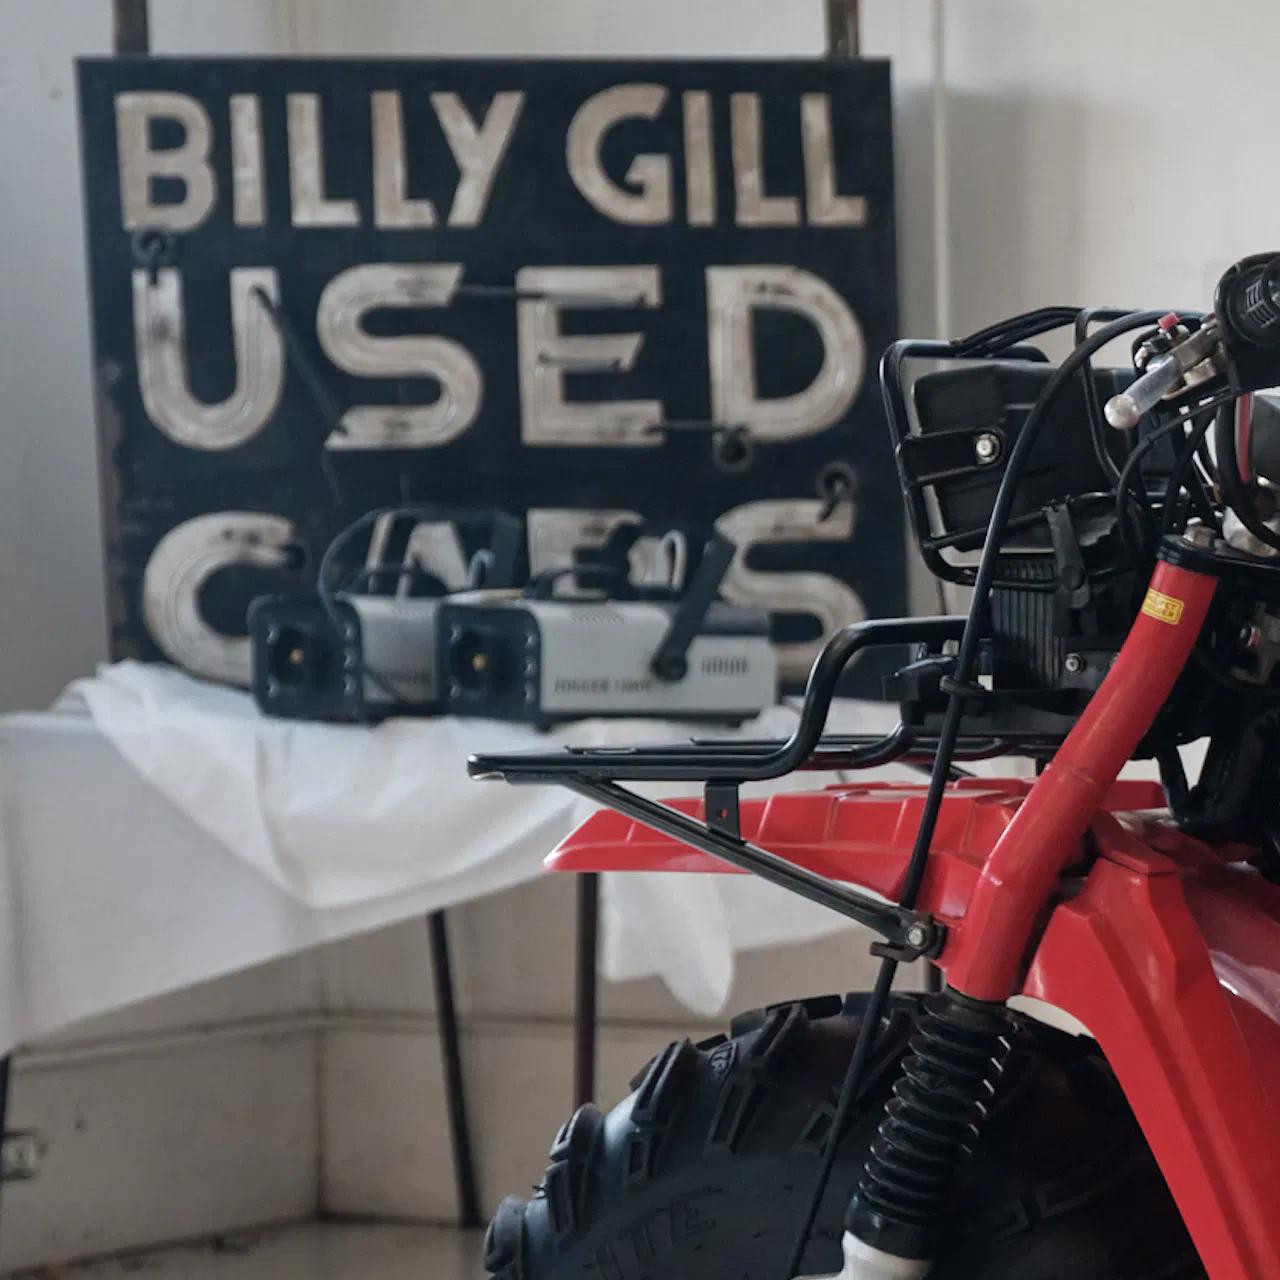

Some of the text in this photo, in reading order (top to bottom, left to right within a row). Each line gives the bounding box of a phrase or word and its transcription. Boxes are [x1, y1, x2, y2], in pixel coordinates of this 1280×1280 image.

[115, 84, 867, 232] BILLY GILL
[131, 263, 866, 451] USED
